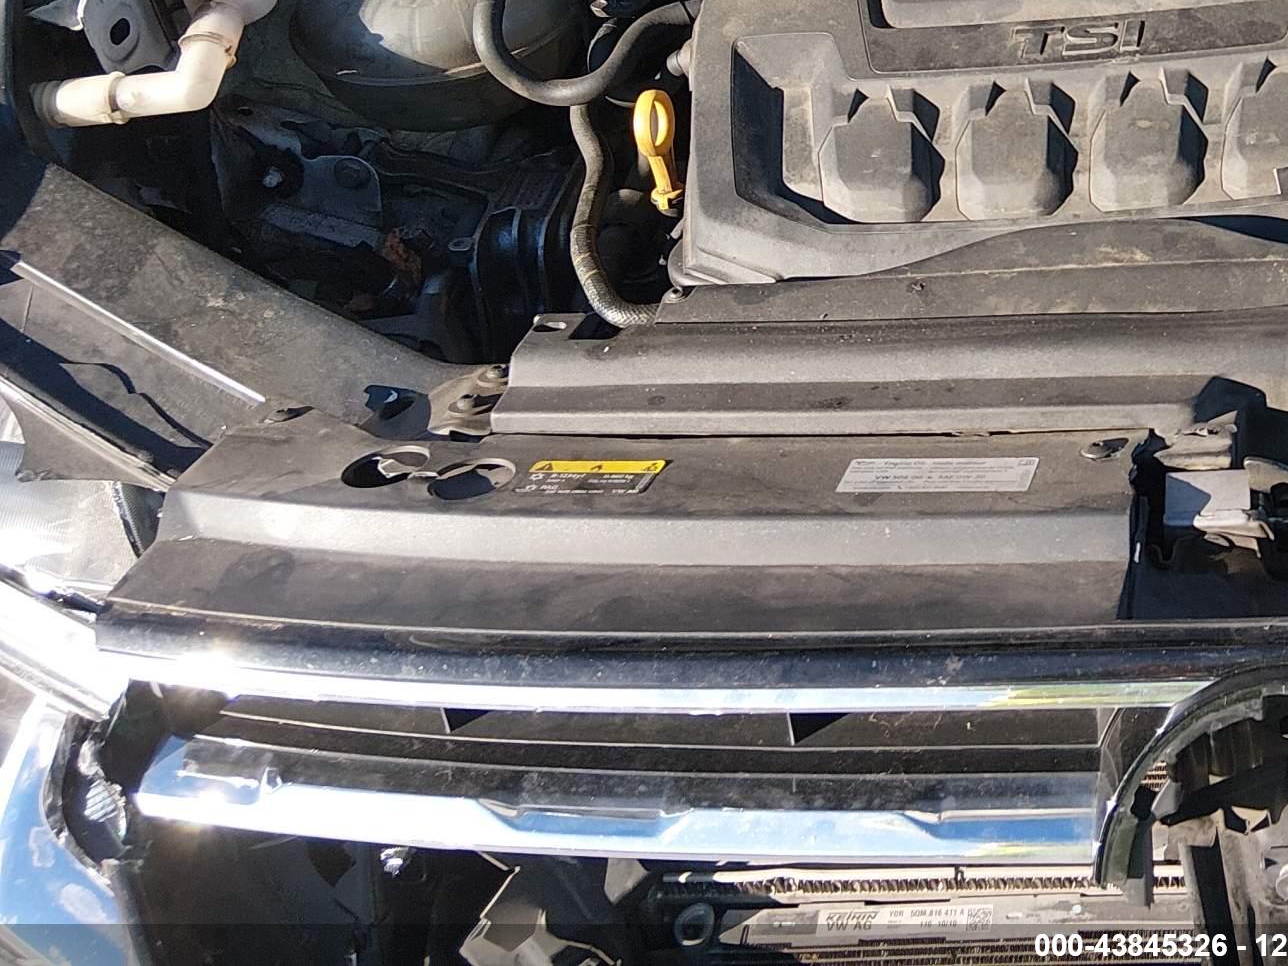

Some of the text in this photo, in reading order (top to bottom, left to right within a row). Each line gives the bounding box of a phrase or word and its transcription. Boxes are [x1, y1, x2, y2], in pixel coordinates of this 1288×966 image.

[1012, 19, 1145, 59] TSI
[827, 921, 849, 931] VW
[853, 920, 873, 931] AG
